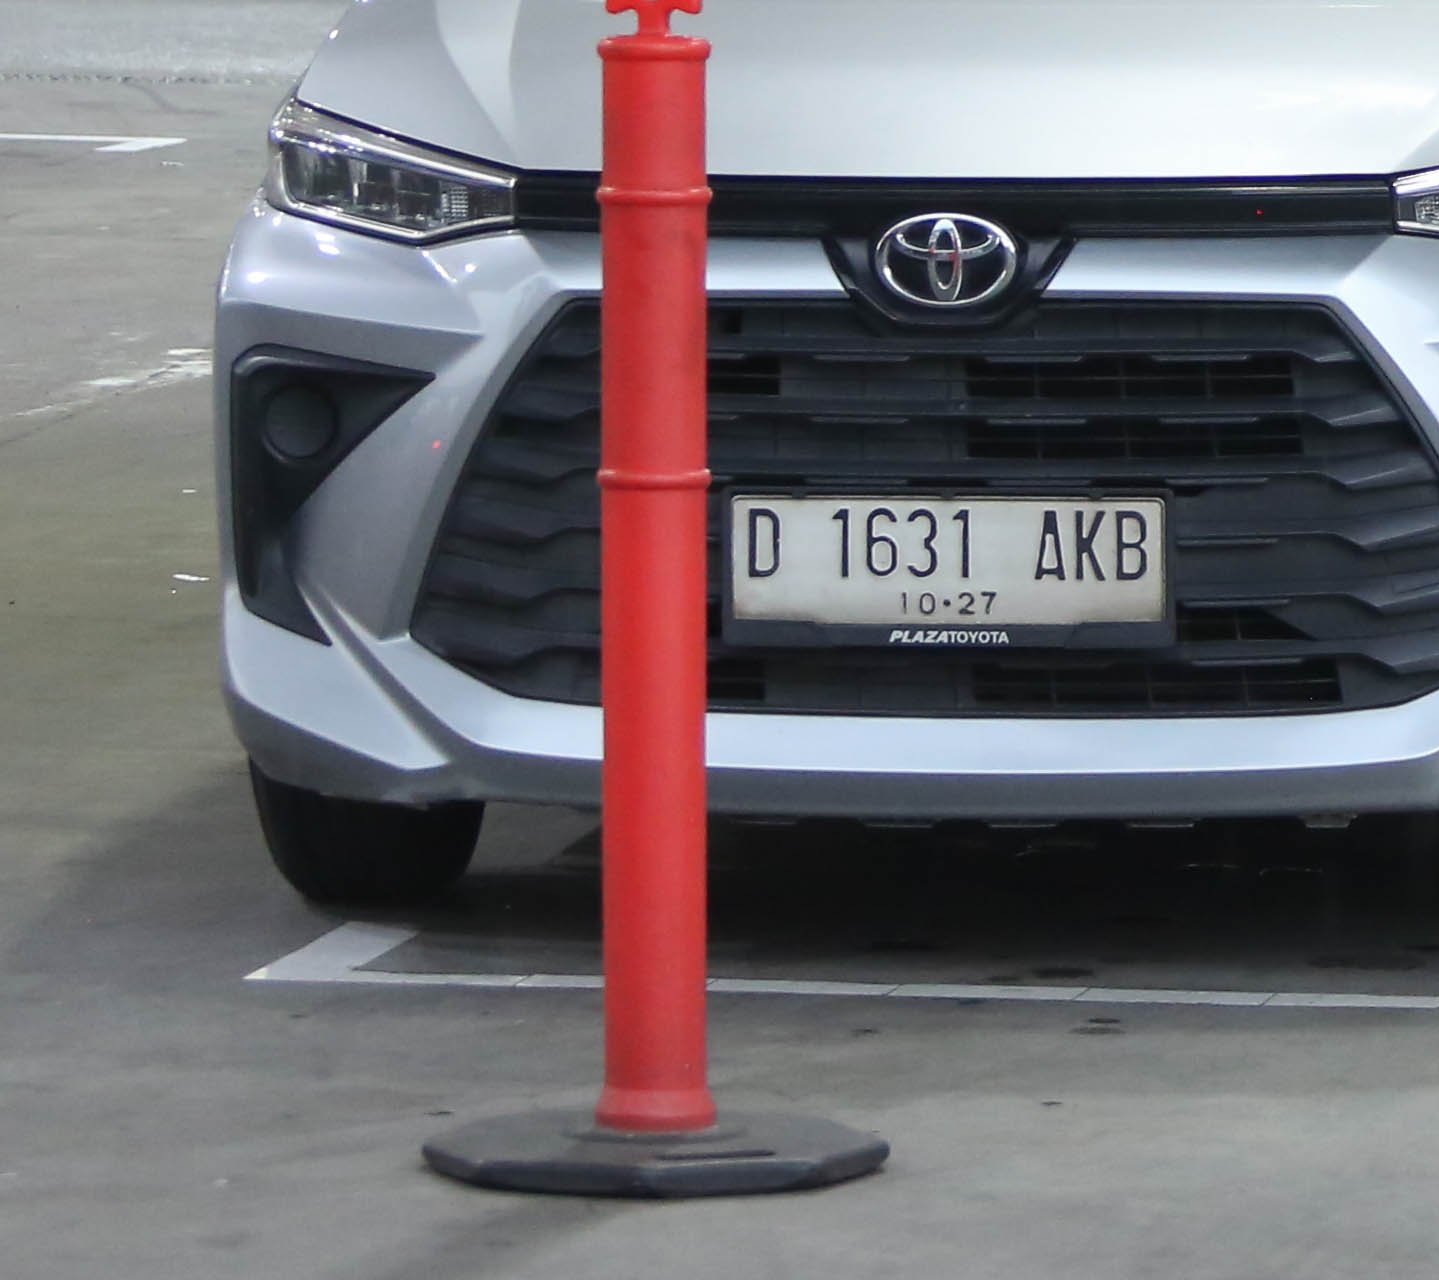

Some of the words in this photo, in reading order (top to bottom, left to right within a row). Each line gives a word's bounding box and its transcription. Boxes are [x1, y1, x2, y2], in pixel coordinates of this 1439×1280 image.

[748, 507, 781, 578] D
[832, 507, 971, 578] 1631
[1035, 509, 1149, 582] AKB
